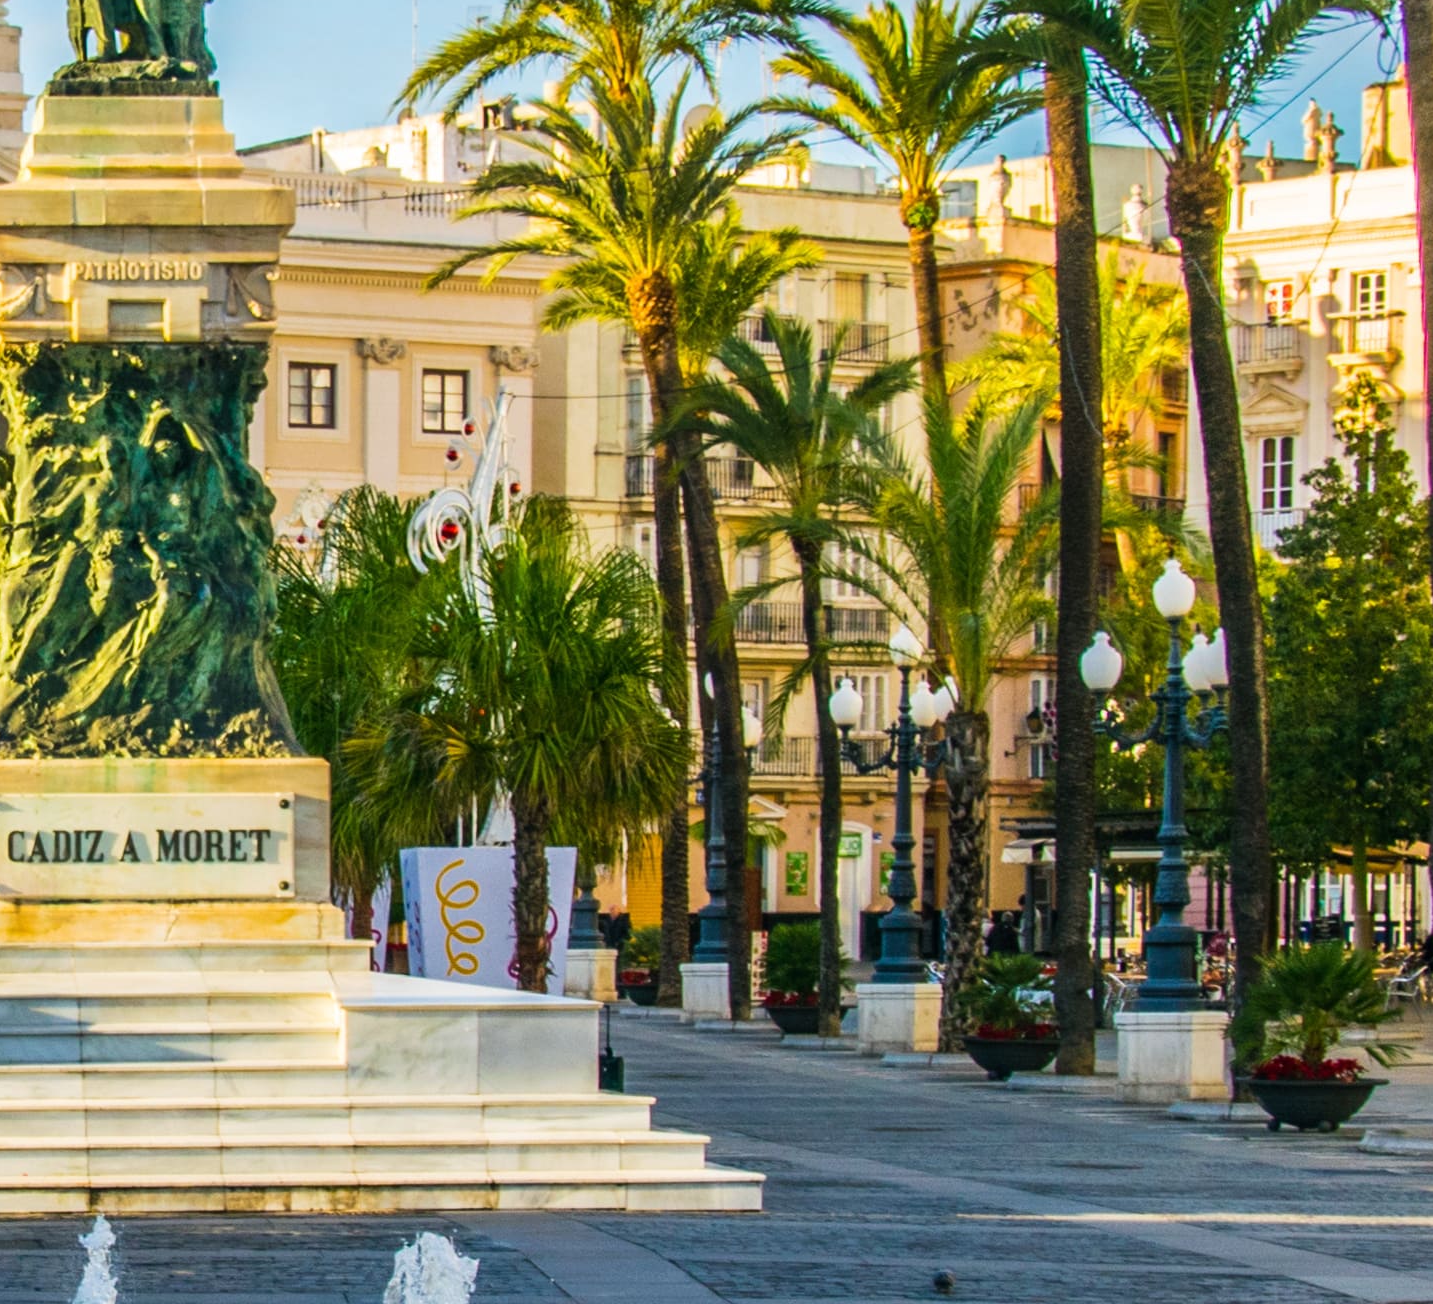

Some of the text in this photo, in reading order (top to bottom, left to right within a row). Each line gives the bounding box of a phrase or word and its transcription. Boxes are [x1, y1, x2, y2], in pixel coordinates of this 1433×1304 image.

[71, 261, 203, 281] PATRIOTISMO
[7, 829, 272, 863] CADIZ A MORET
